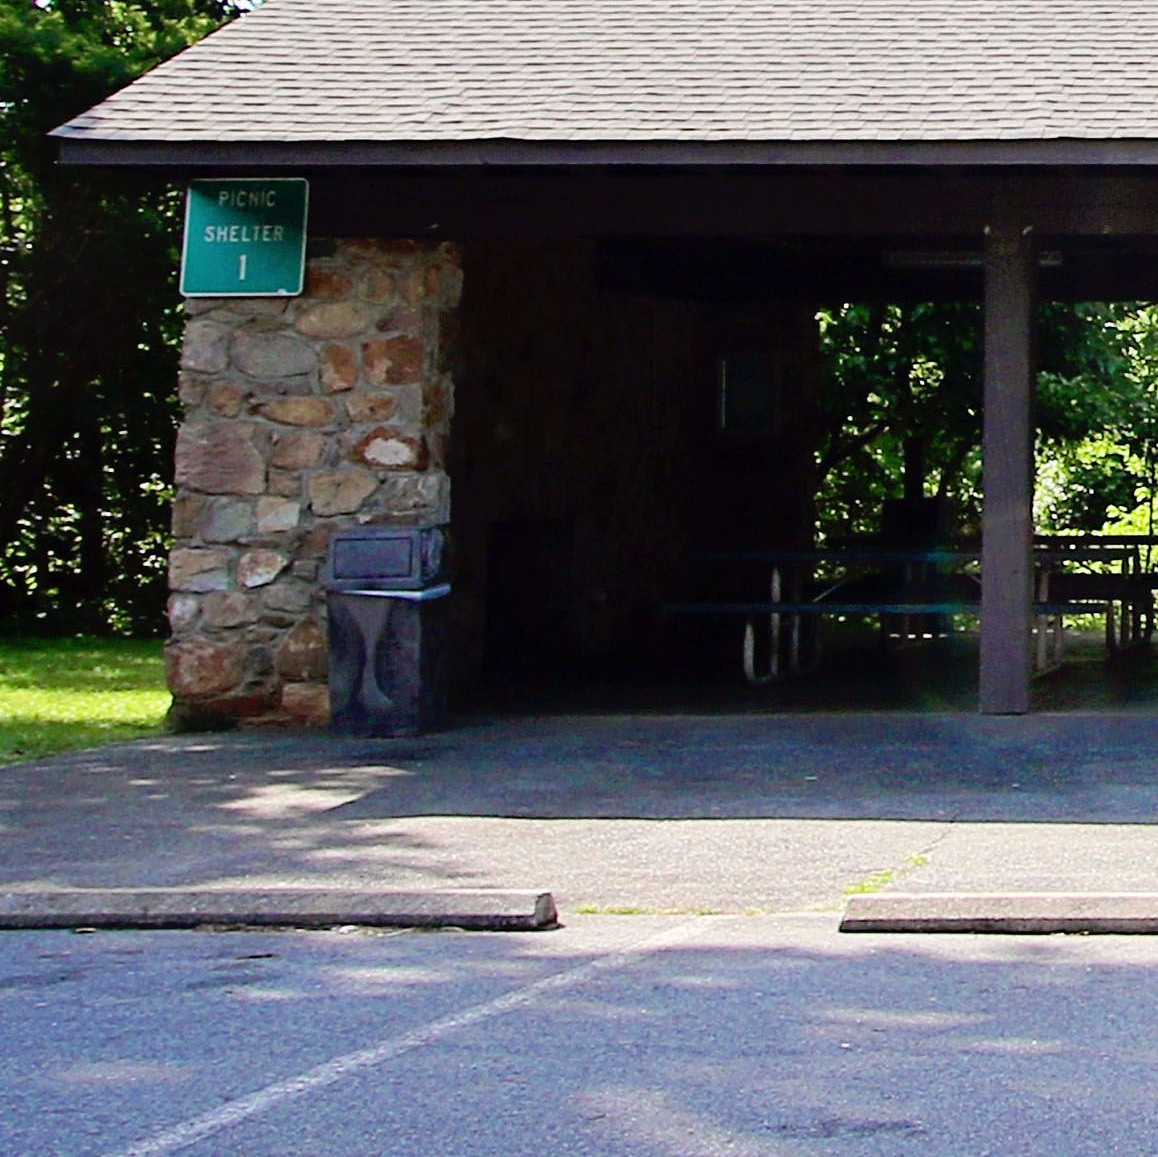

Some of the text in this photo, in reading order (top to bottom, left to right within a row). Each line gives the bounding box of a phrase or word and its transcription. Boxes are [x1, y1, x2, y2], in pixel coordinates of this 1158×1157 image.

[218, 191, 277, 207] PICNIC
[203, 225, 284, 243] SHELTER
[239, 254, 247, 280] 1
